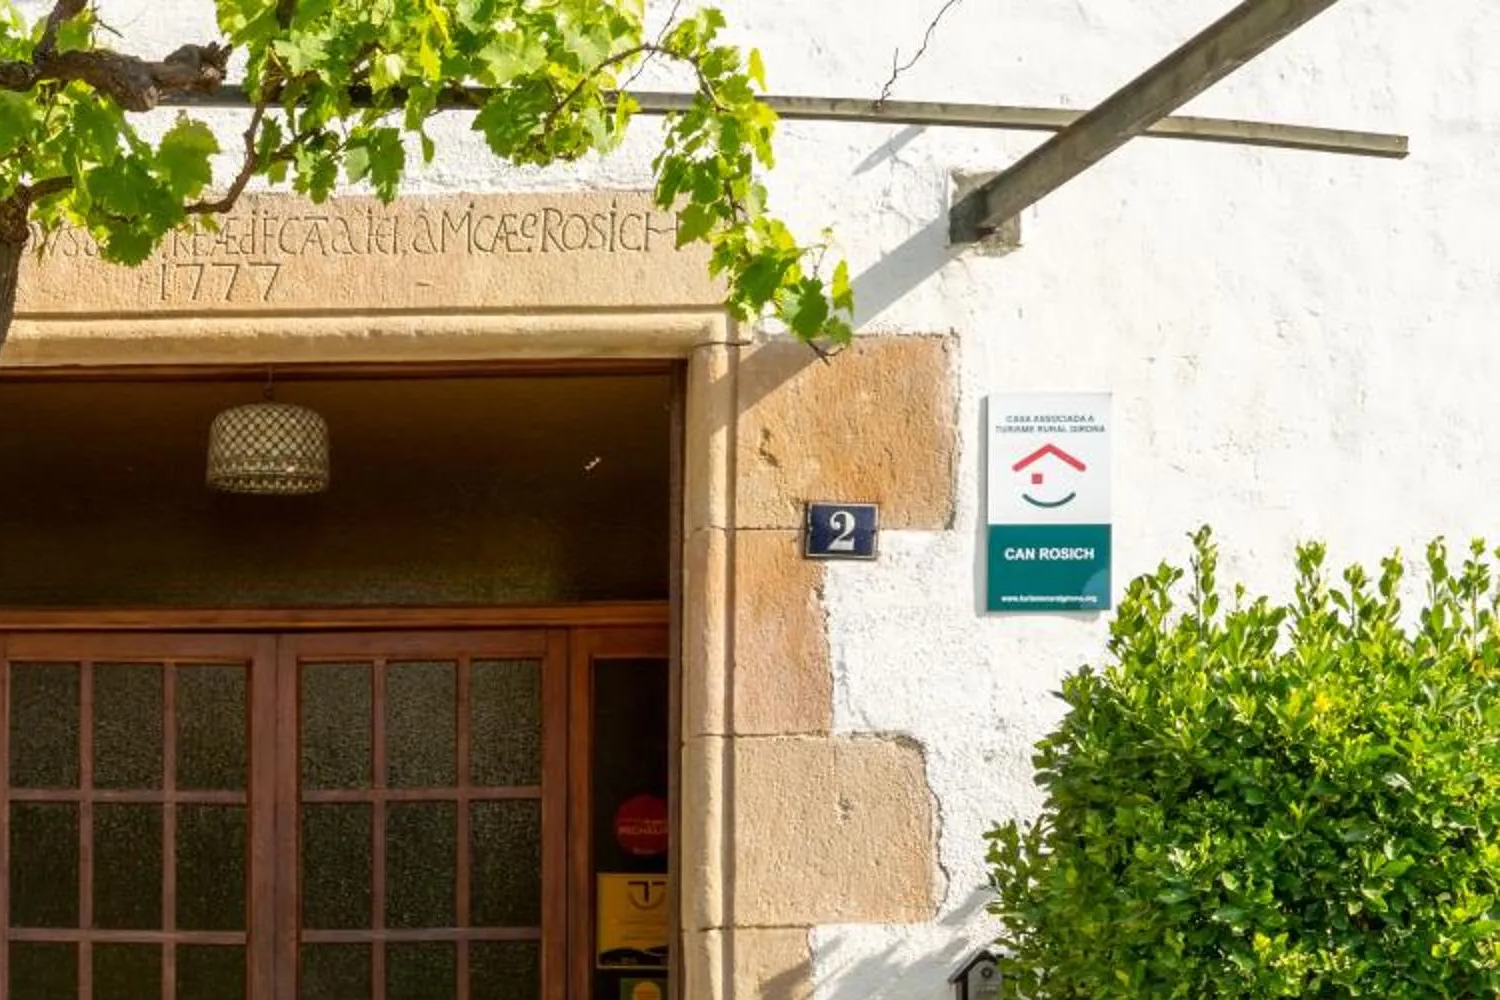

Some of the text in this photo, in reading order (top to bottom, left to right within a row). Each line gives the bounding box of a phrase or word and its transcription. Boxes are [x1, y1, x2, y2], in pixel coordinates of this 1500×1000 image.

[159, 253, 282, 301] 1777
[828, 511, 856, 551] 2
[1004, 547, 1095, 560] CAN ROSICH
